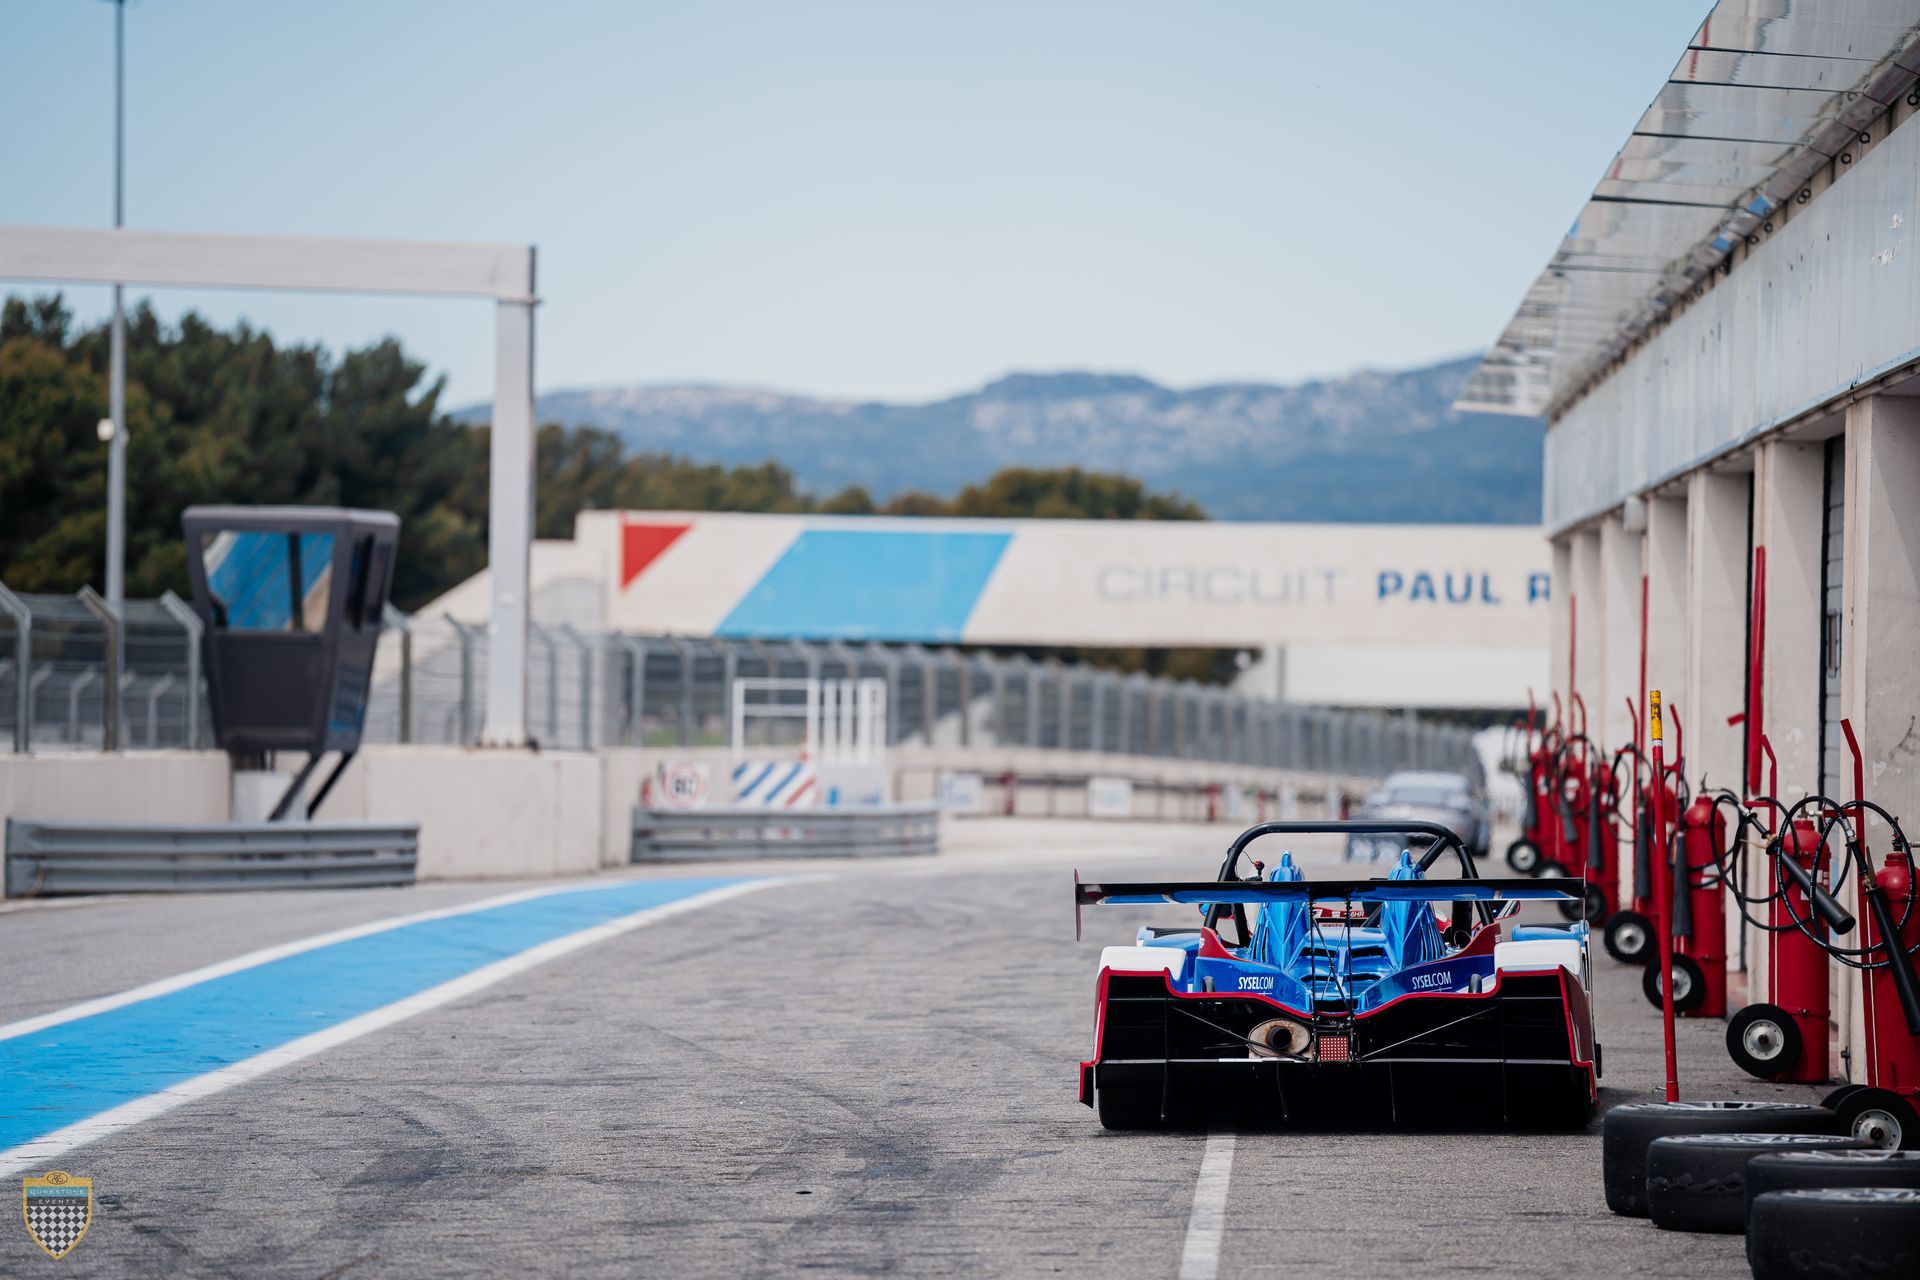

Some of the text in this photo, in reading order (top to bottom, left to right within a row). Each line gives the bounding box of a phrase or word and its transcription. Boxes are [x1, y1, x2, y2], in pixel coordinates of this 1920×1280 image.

[1096, 563, 1346, 605] CIRCUIT
[1377, 569, 1501, 605] PAUL
[1238, 976, 1274, 990] SYSELCOM
[1411, 970, 1452, 990] SYSELCOM
